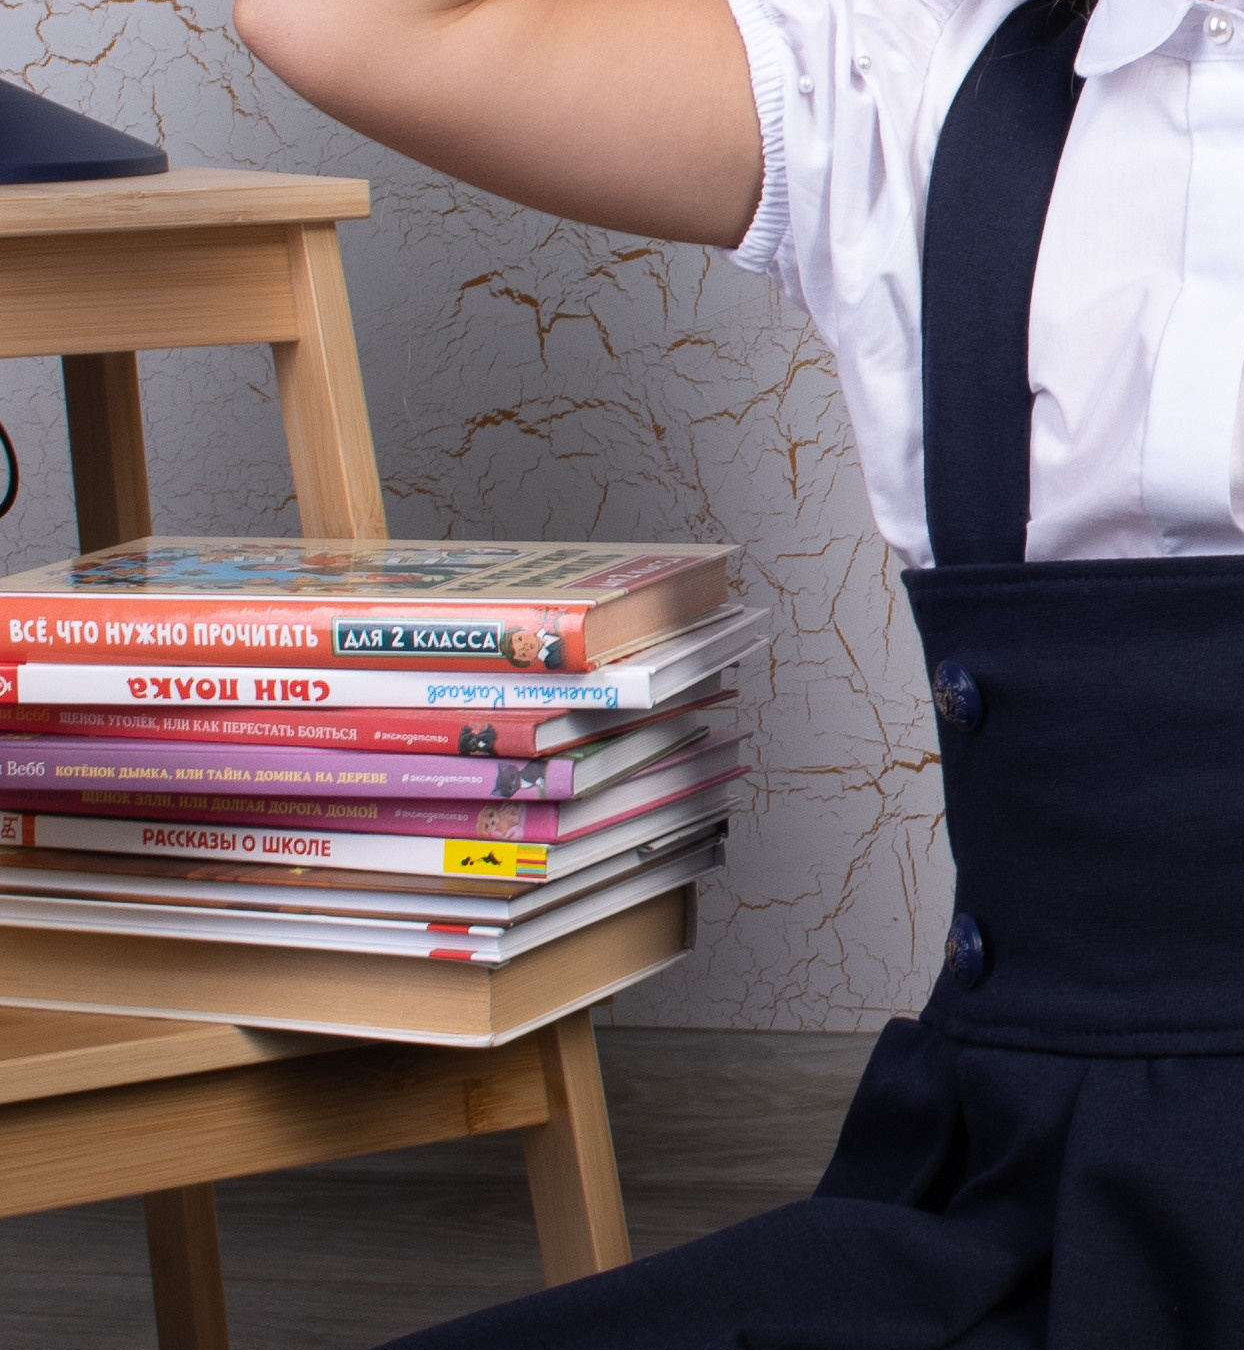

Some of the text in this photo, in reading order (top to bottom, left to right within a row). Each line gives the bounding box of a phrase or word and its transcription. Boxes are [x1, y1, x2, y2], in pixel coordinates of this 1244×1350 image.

[9, 616, 319, 648] ВСЁ, ЧТО НУЖНО ПРОЧИТАТЬ
[343, 626, 497, 650] ДЛЯ 2 КЛАССА
[427, 684, 618, 708] Валентин Катаев
[60, 712, 105, 726] ЩЕНОК
[108, 713, 160, 730] УГОЛЁК,
[163, 717, 190, 731] ИЛИ
[193, 719, 219, 733] КАК
[222, 721, 295, 737] ПЕРЕСТАТЬ
[298, 725, 358, 741] БОЯТЬСЯ
[7, 760, 388, 784] Вебб КОТЁНОК ДЫМКА, ИЛИ ТАЙНА ДОМИКА НА ДЕРЕВЕ
[81, 791, 131, 804] ЩЕНОК
[179, 795, 208, 809] ИЛИ
[211, 797, 265, 812] ДОЛГАЯ
[268, 801, 322, 816] ДОРОГА
[326, 803, 378, 819] ДОМОЙ
[143, 828, 331, 857] РАССКАЗЫ О ШКОЛЕ
